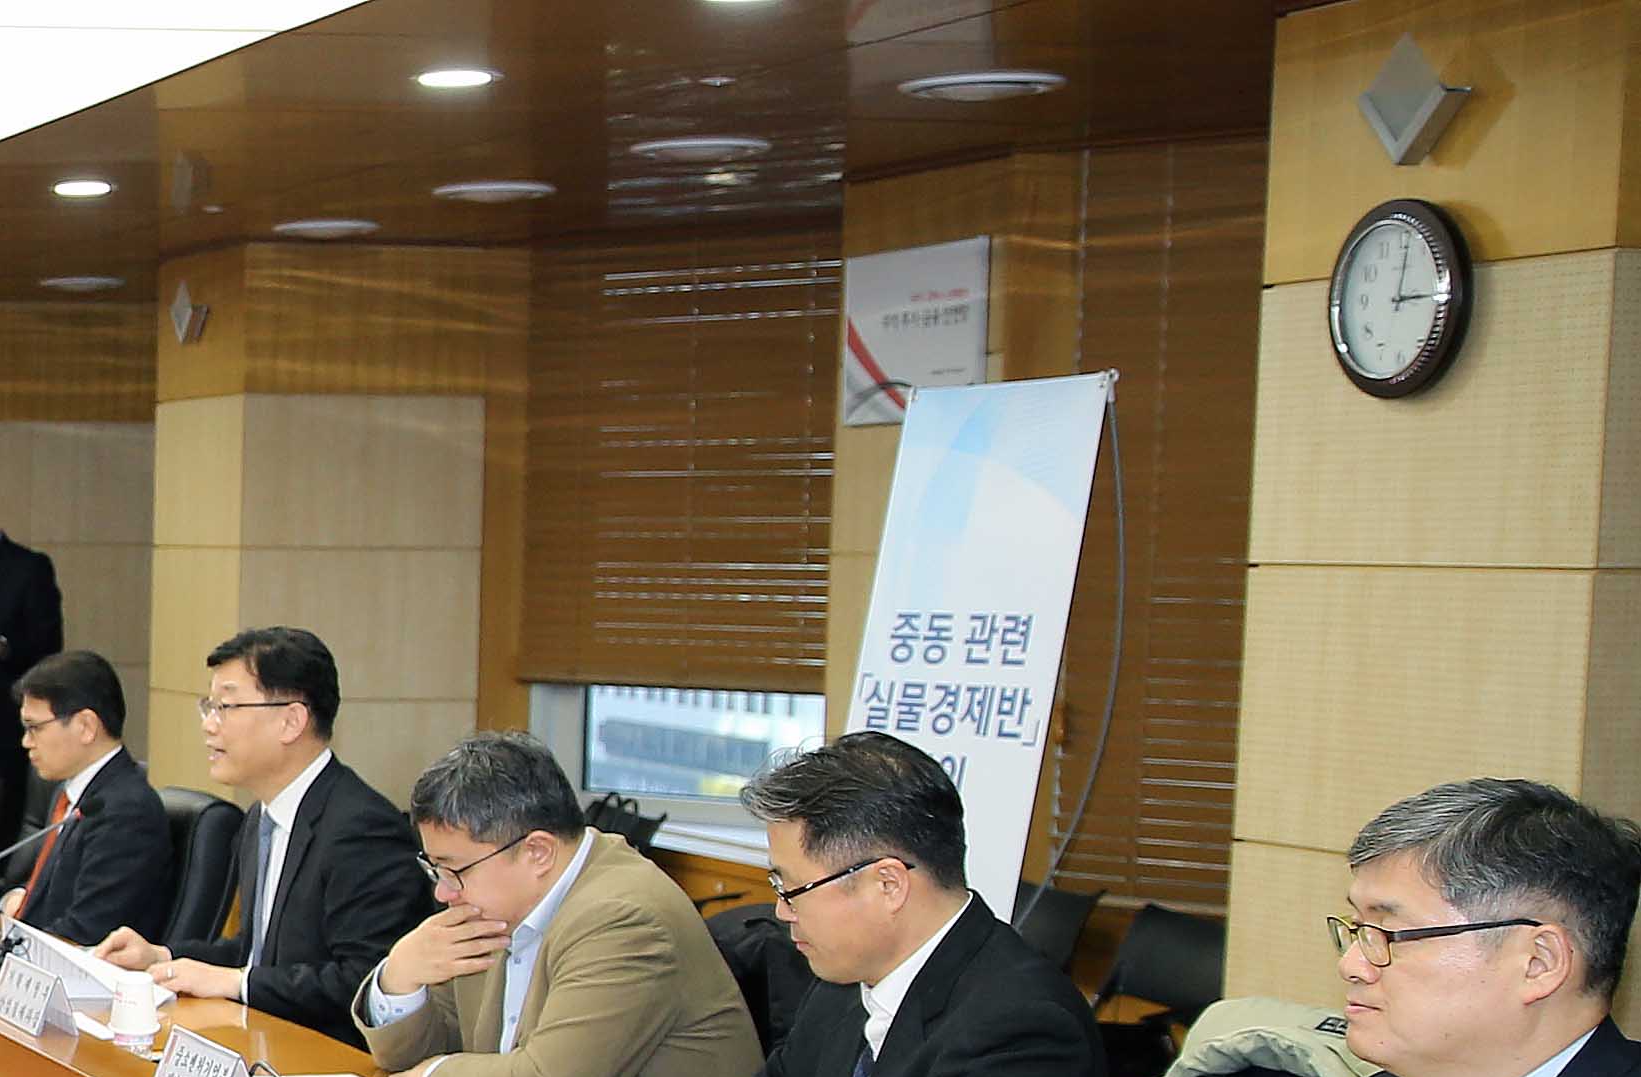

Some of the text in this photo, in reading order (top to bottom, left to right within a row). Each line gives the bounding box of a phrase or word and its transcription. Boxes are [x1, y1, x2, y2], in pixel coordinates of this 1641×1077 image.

[890, 613, 1032, 665] 중동 관련
[858, 672, 1041, 747] 「실물경제반」
